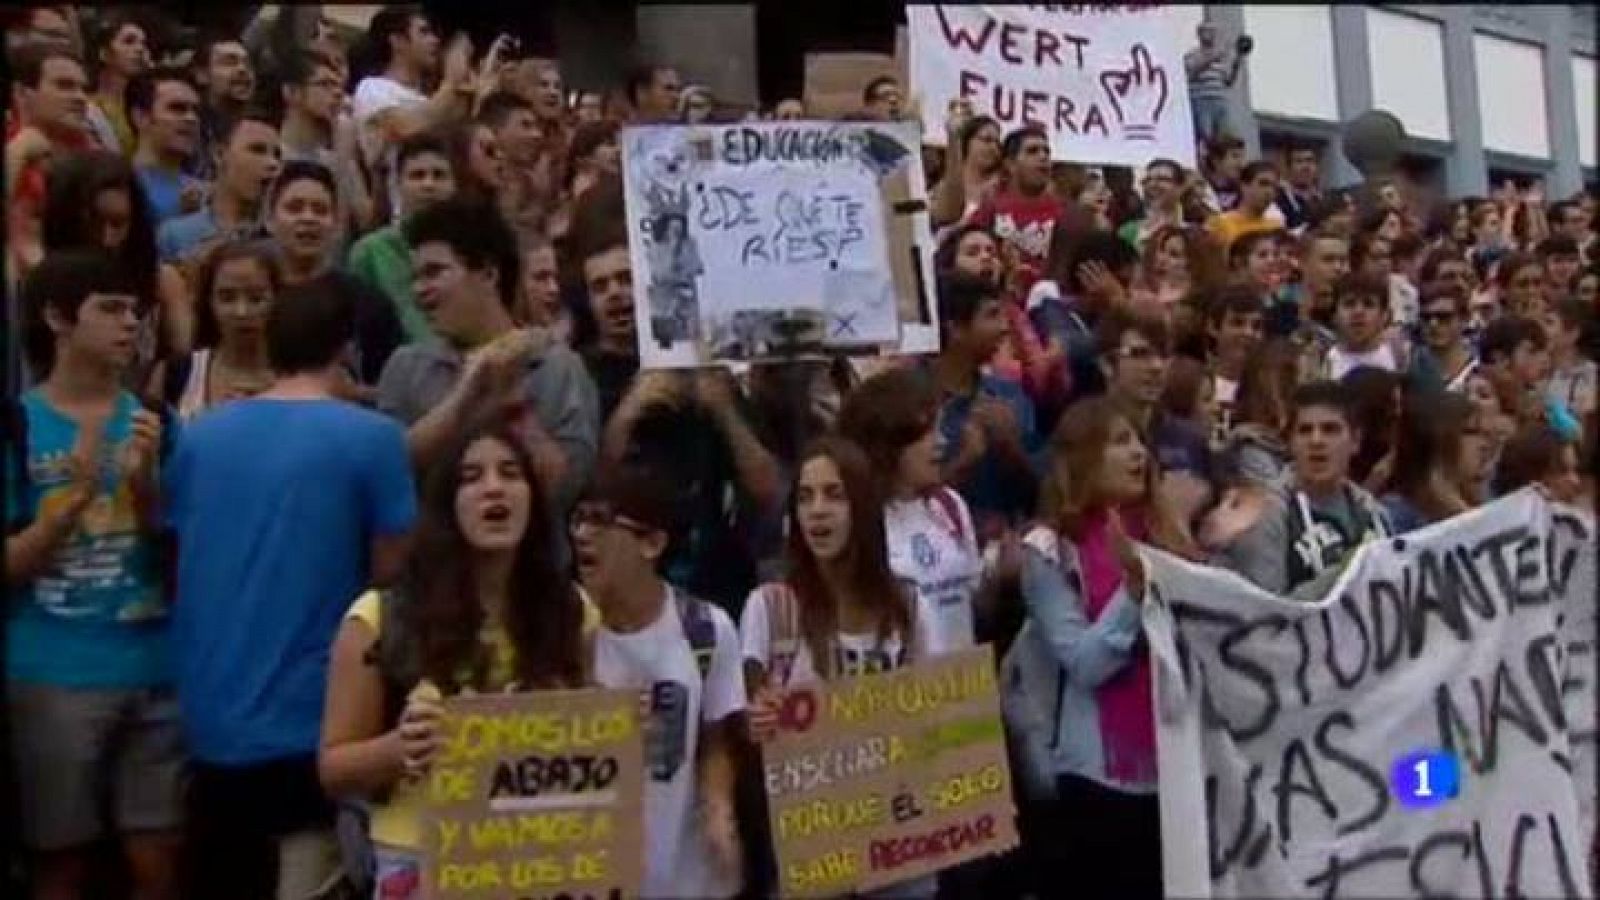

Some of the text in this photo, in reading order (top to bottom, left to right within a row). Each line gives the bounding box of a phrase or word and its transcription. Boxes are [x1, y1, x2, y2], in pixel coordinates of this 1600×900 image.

[935, 5, 1090, 69] WERT
[959, 70, 1108, 137] FUERA
[488, 755, 620, 800] ABAJO
